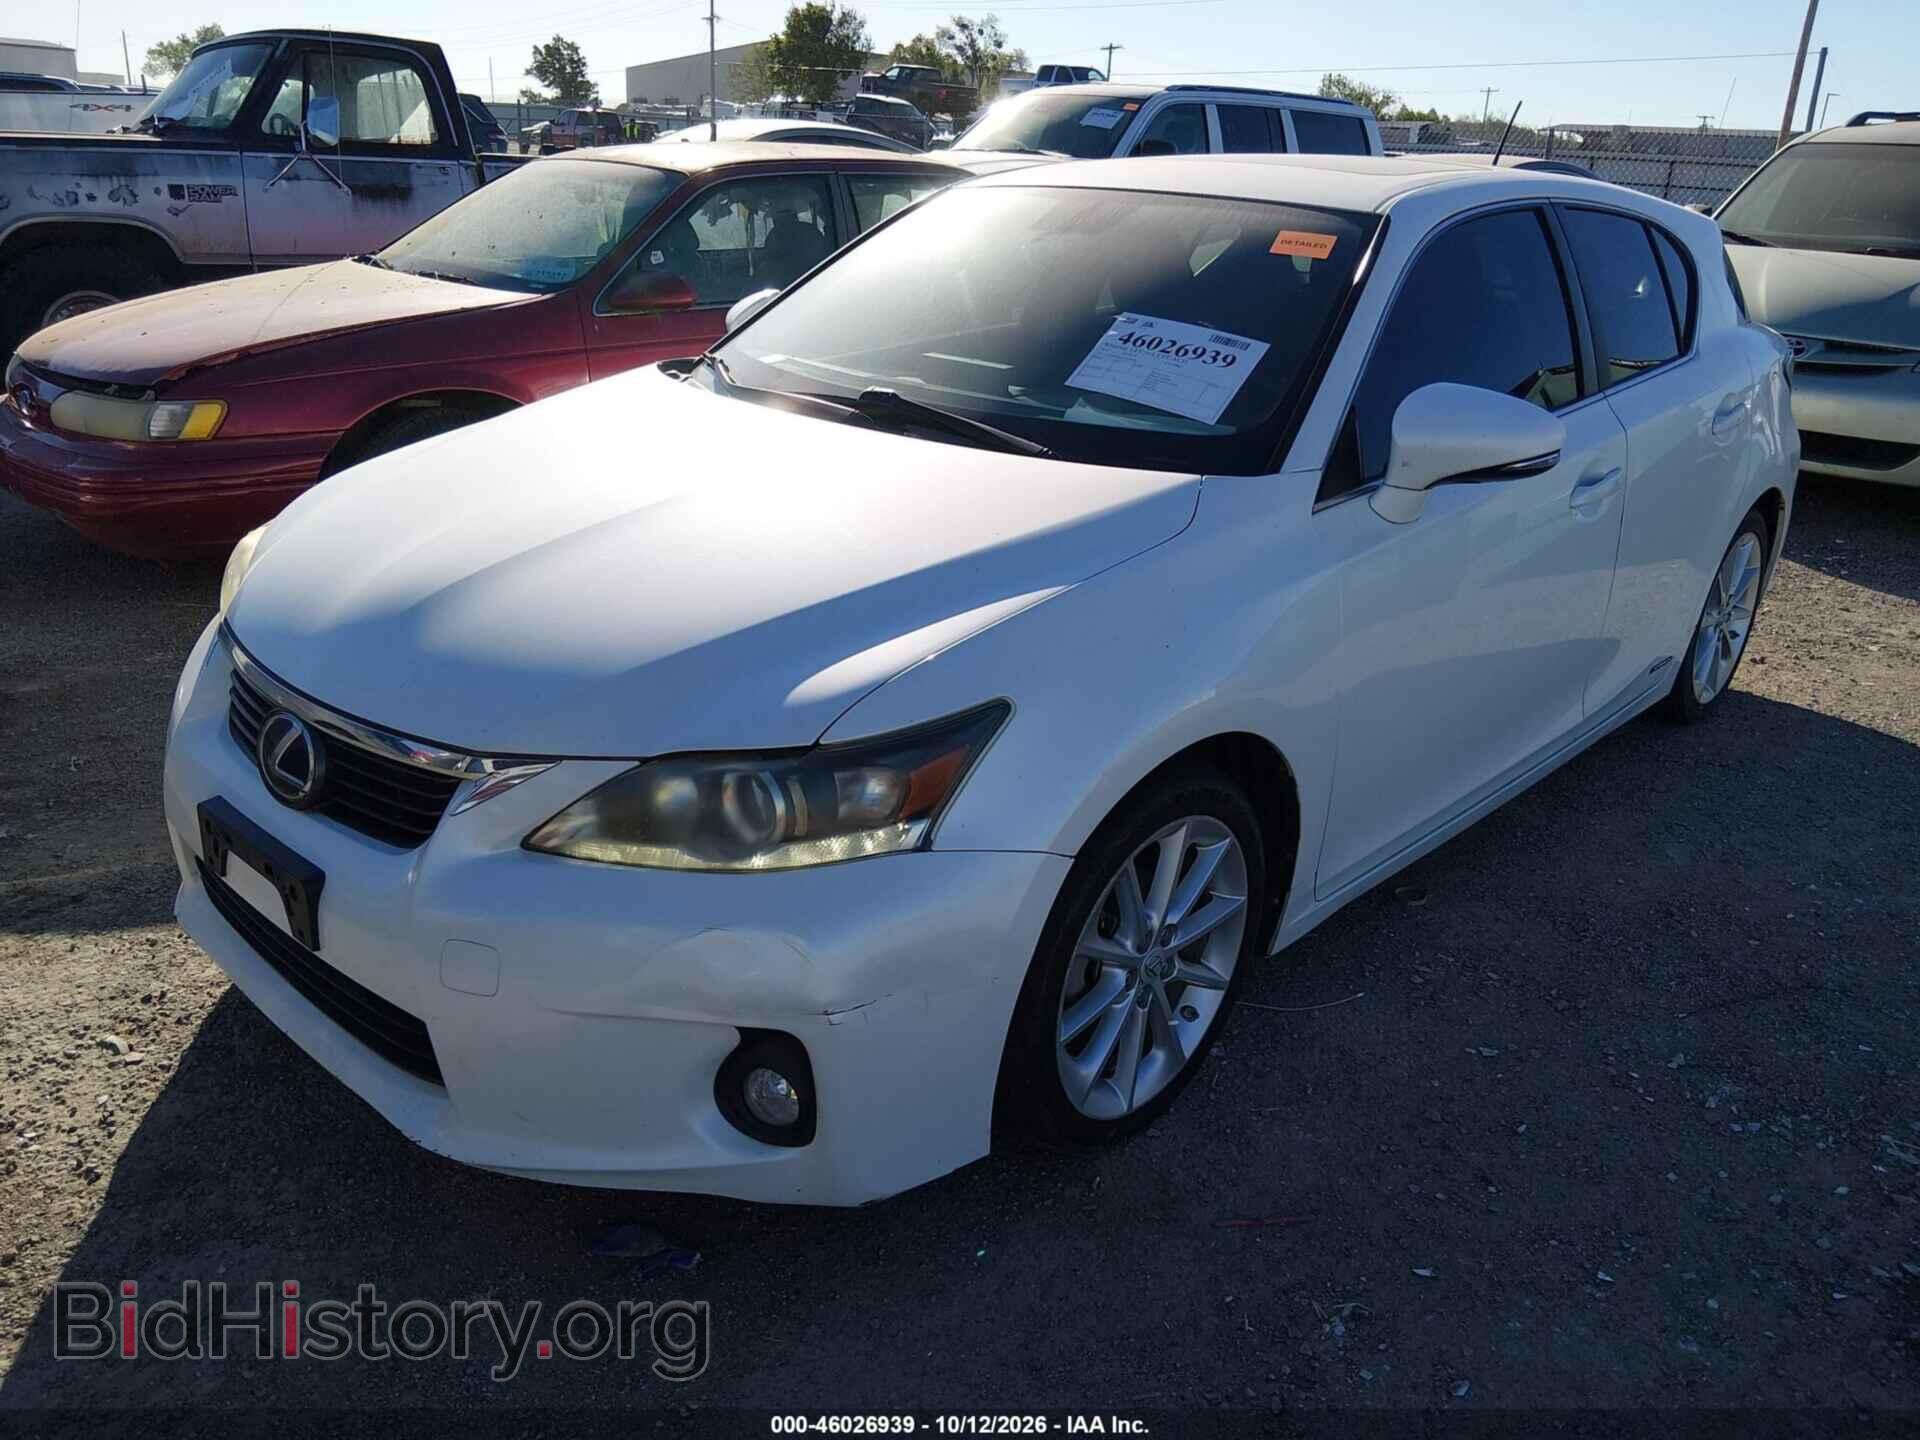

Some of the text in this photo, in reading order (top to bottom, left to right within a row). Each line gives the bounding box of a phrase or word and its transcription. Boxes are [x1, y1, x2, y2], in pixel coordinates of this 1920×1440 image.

[187, 184, 238, 197] POWER
[187, 191, 222, 203] RAM
[1279, 238, 1329, 250] DETAILED
[1117, 331, 1237, 368] 46026939
